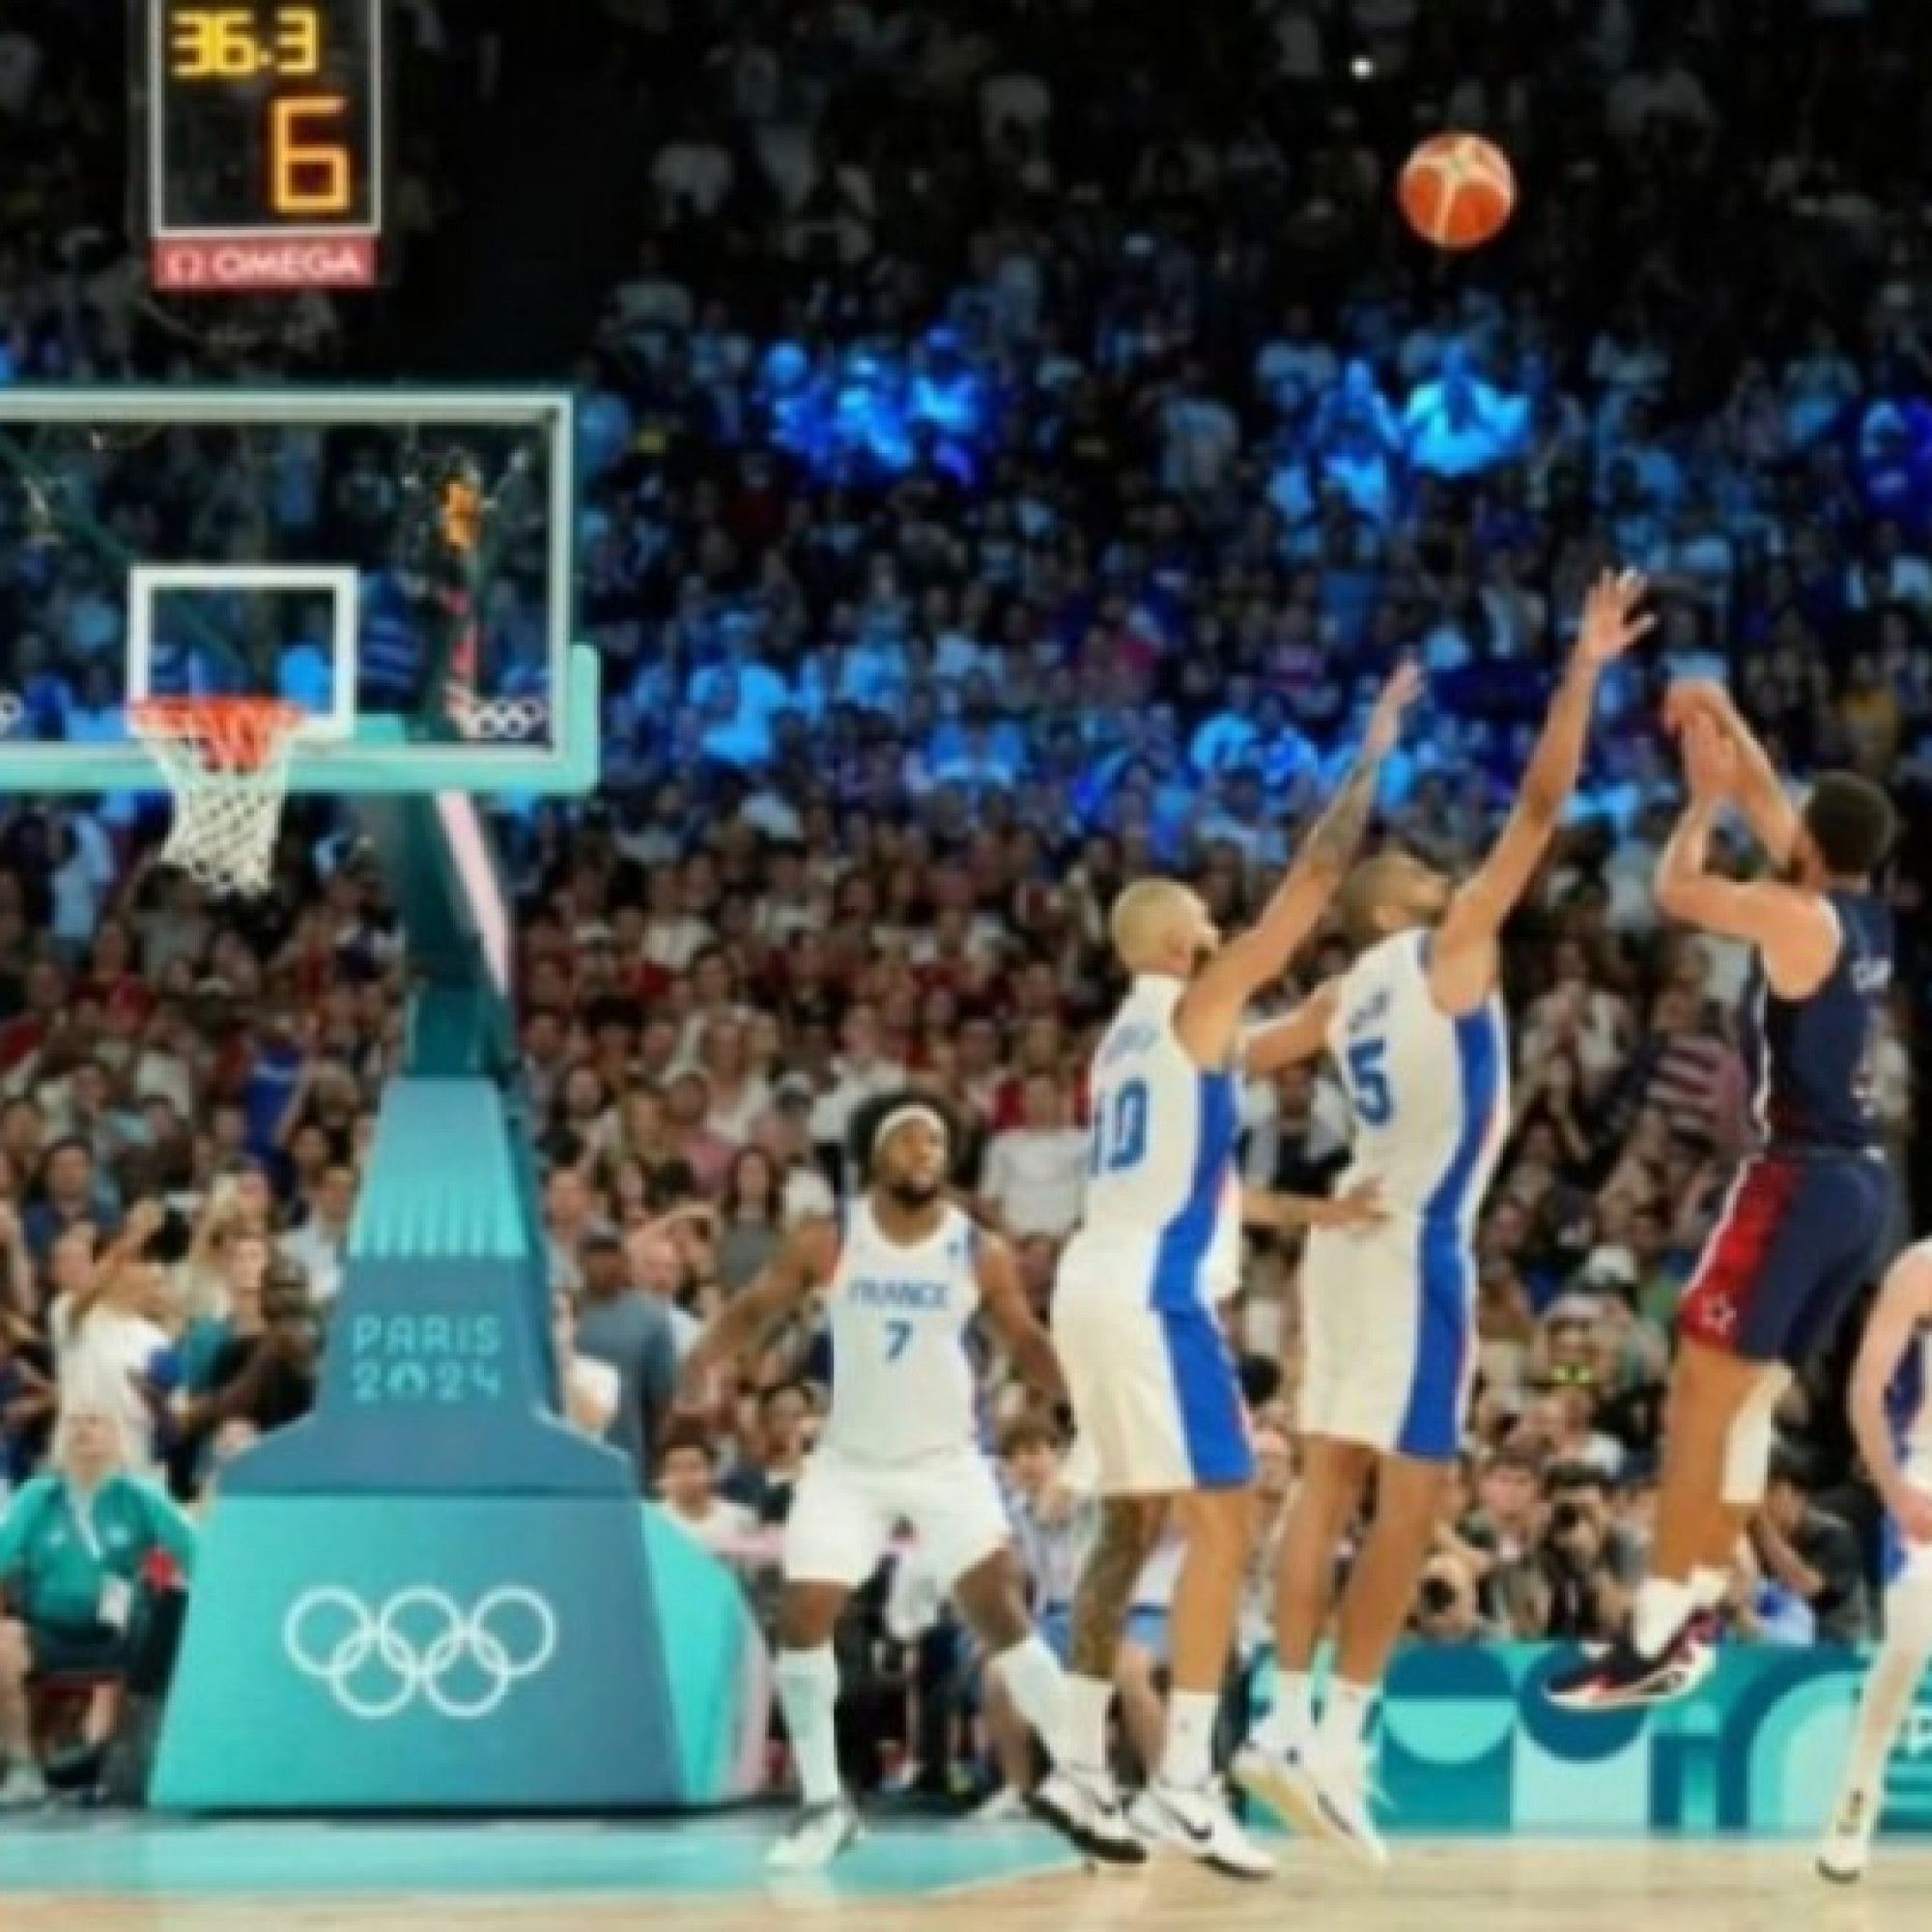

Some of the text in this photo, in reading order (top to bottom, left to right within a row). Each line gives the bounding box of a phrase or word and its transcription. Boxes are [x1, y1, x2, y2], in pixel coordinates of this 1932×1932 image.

[171, 10, 317, 75] 36.3
[273, 97, 350, 213] 6
[212, 244, 363, 283] OMEGA
[1348, 1037, 1393, 1125] 5
[846, 1279, 951, 1310] FRANCE
[354, 1314, 501, 1355] PARIS
[884, 1319, 914, 1364] 7
[352, 1360, 501, 1401] 2024
